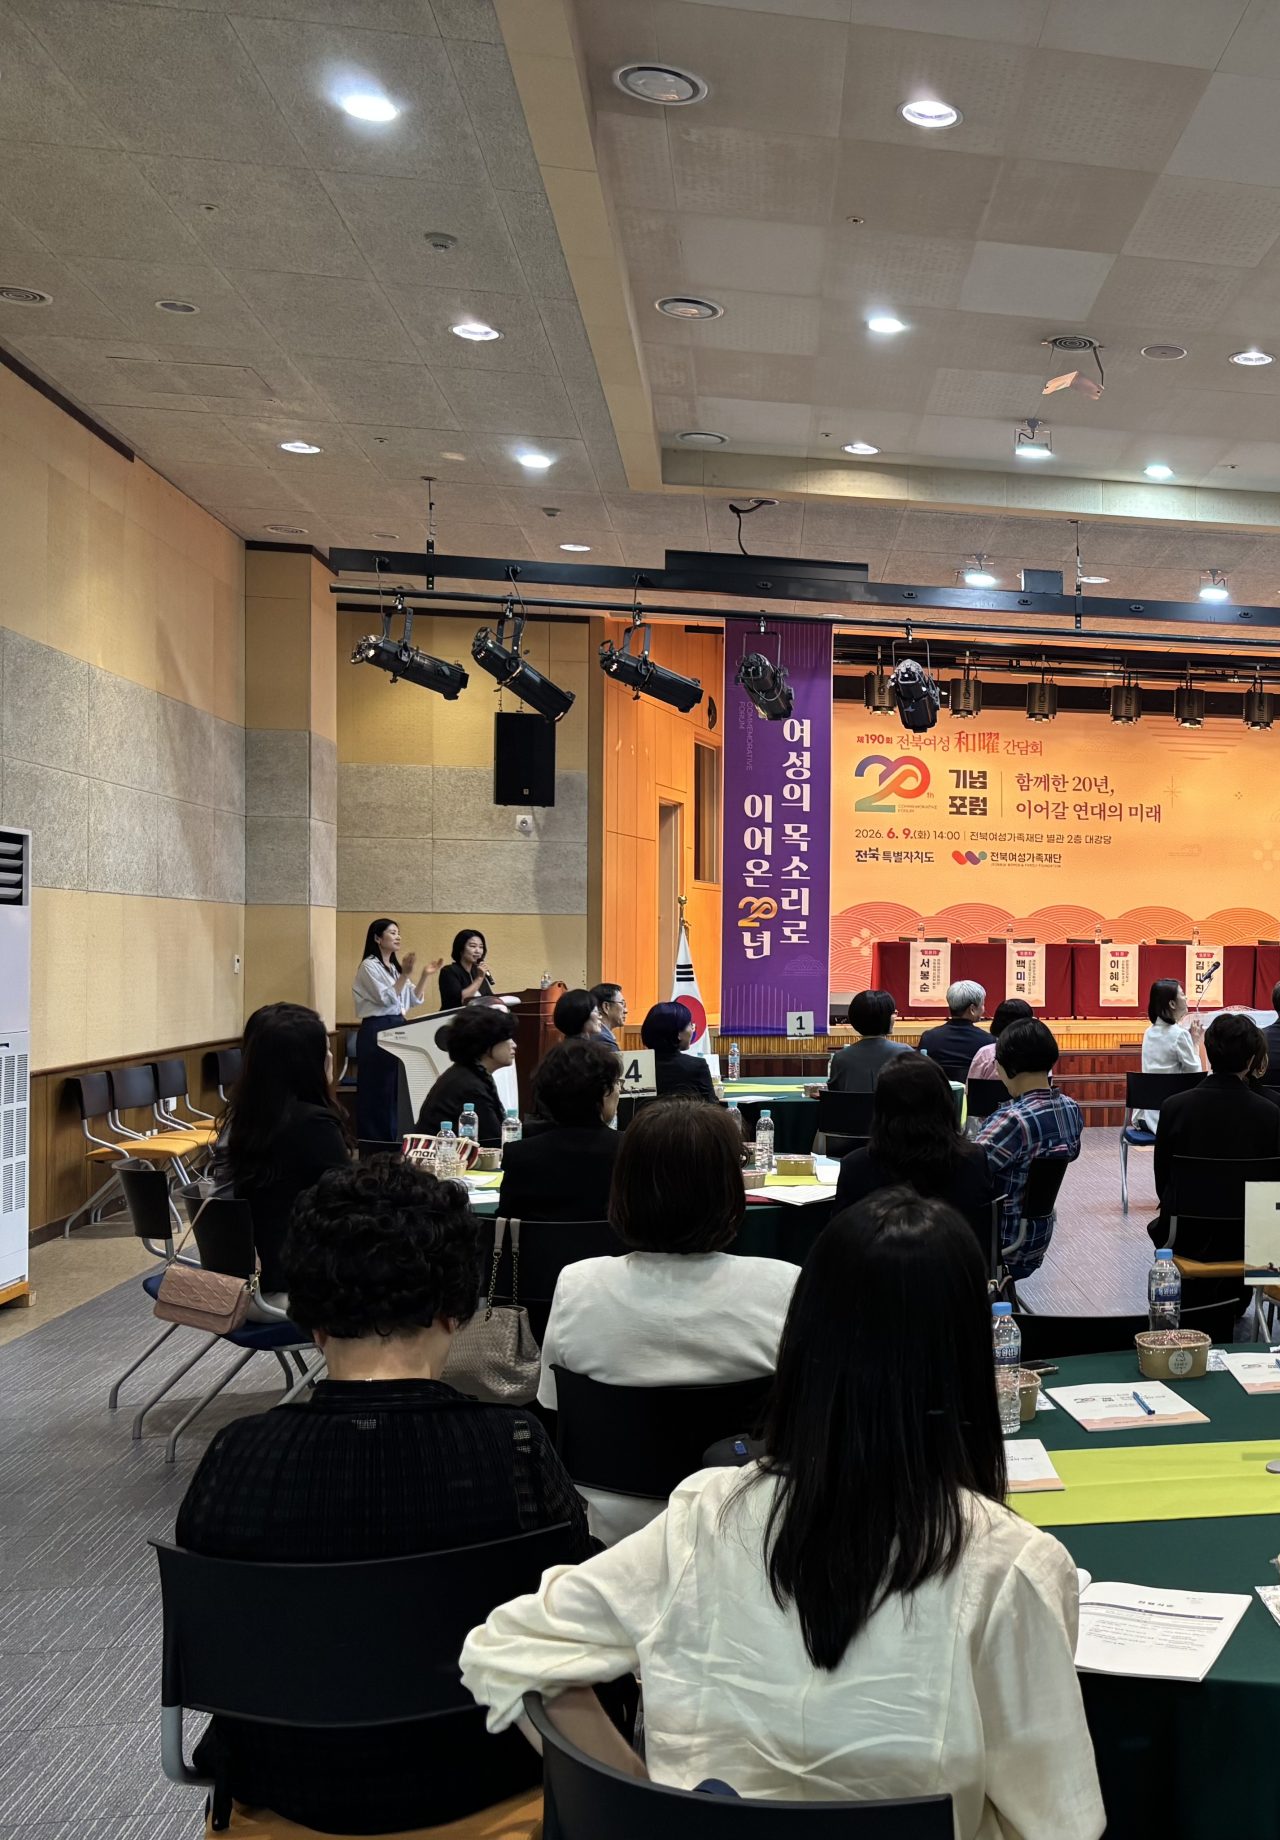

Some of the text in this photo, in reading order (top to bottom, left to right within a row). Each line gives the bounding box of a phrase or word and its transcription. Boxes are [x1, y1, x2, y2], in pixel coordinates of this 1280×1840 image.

[856, 733, 893, 745] 제190회
[896, 734, 950, 752] 전북여성
[1003, 739, 1043, 756] 간담회
[948, 769, 988, 790] 기념
[1015, 772, 1115, 796] 함께한 20년,
[948, 795, 988, 817] 포럼
[1015, 799, 1161, 824] 이어갈 연대의 미래
[742, 793, 773, 888] 이어온
[780, 718, 811, 945] 여성의 목소리로
[855, 828, 884, 839] 2026.
[932, 830, 960, 841] 14:00
[969, 831, 1044, 843] 전북여성가족재단
[855, 847, 935, 864] 전북 특별자치도
[990, 851, 1062, 863] 전북여성가족재단
[920, 958, 930, 993] 서봉순
[1109, 959, 1119, 993] 이혜숙
[796, 1015, 806, 1030] 1
[625, 1059, 642, 1083] 4
